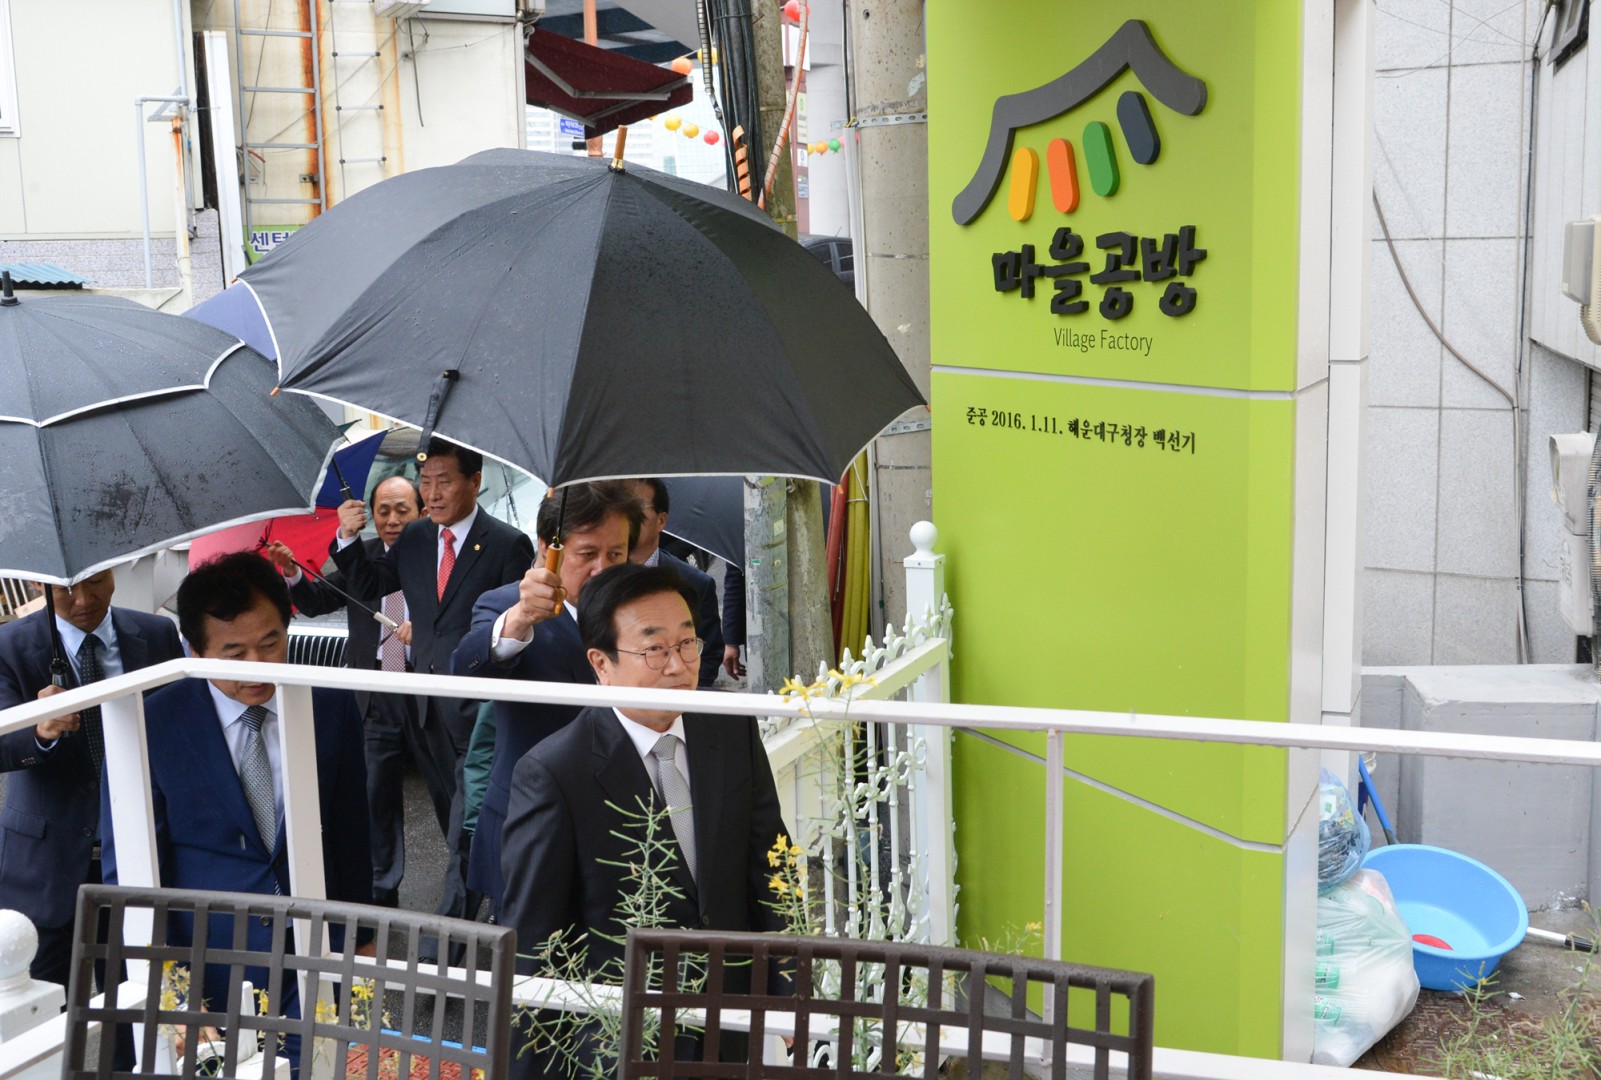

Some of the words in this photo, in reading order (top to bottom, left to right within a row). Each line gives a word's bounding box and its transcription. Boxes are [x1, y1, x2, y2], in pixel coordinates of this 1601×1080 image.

[991, 225, 1208, 320] 마을공방
[1053, 327, 1096, 353] Village
[1100, 329, 1153, 357] Factory
[966, 406, 988, 426] 준공
[991, 410, 1026, 430] 2016.
[1067, 417, 1148, 448] 해운대구청장
[1152, 428, 1195, 454] 백선기
